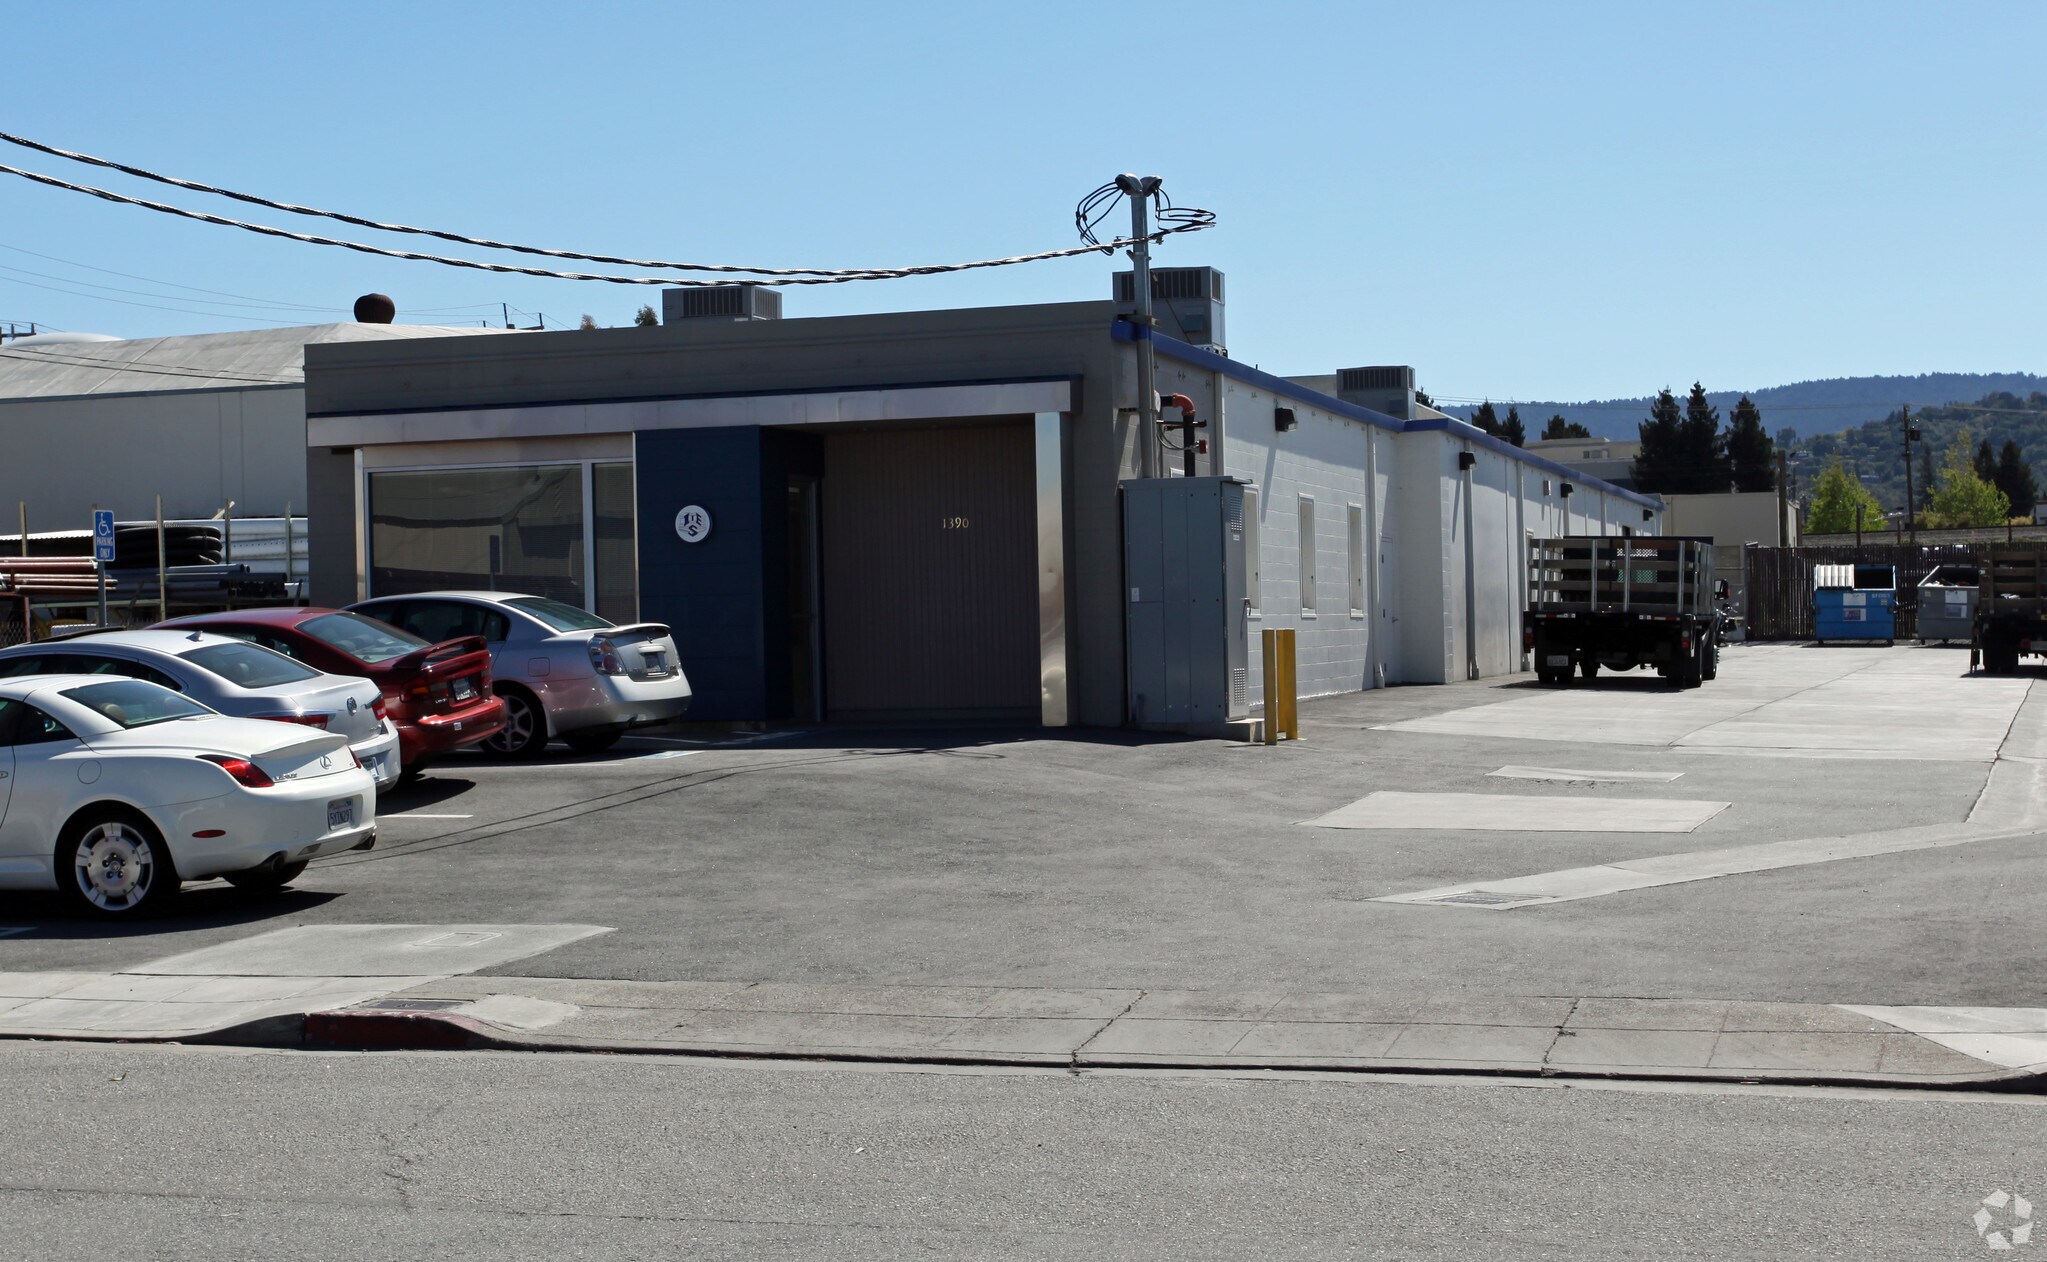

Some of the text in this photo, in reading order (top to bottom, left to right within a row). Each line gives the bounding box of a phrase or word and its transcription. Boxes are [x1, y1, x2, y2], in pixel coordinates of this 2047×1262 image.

[943, 516, 969, 529] 1390
[96, 536, 113, 547] PARKING
[99, 547, 111, 558] ONLY
